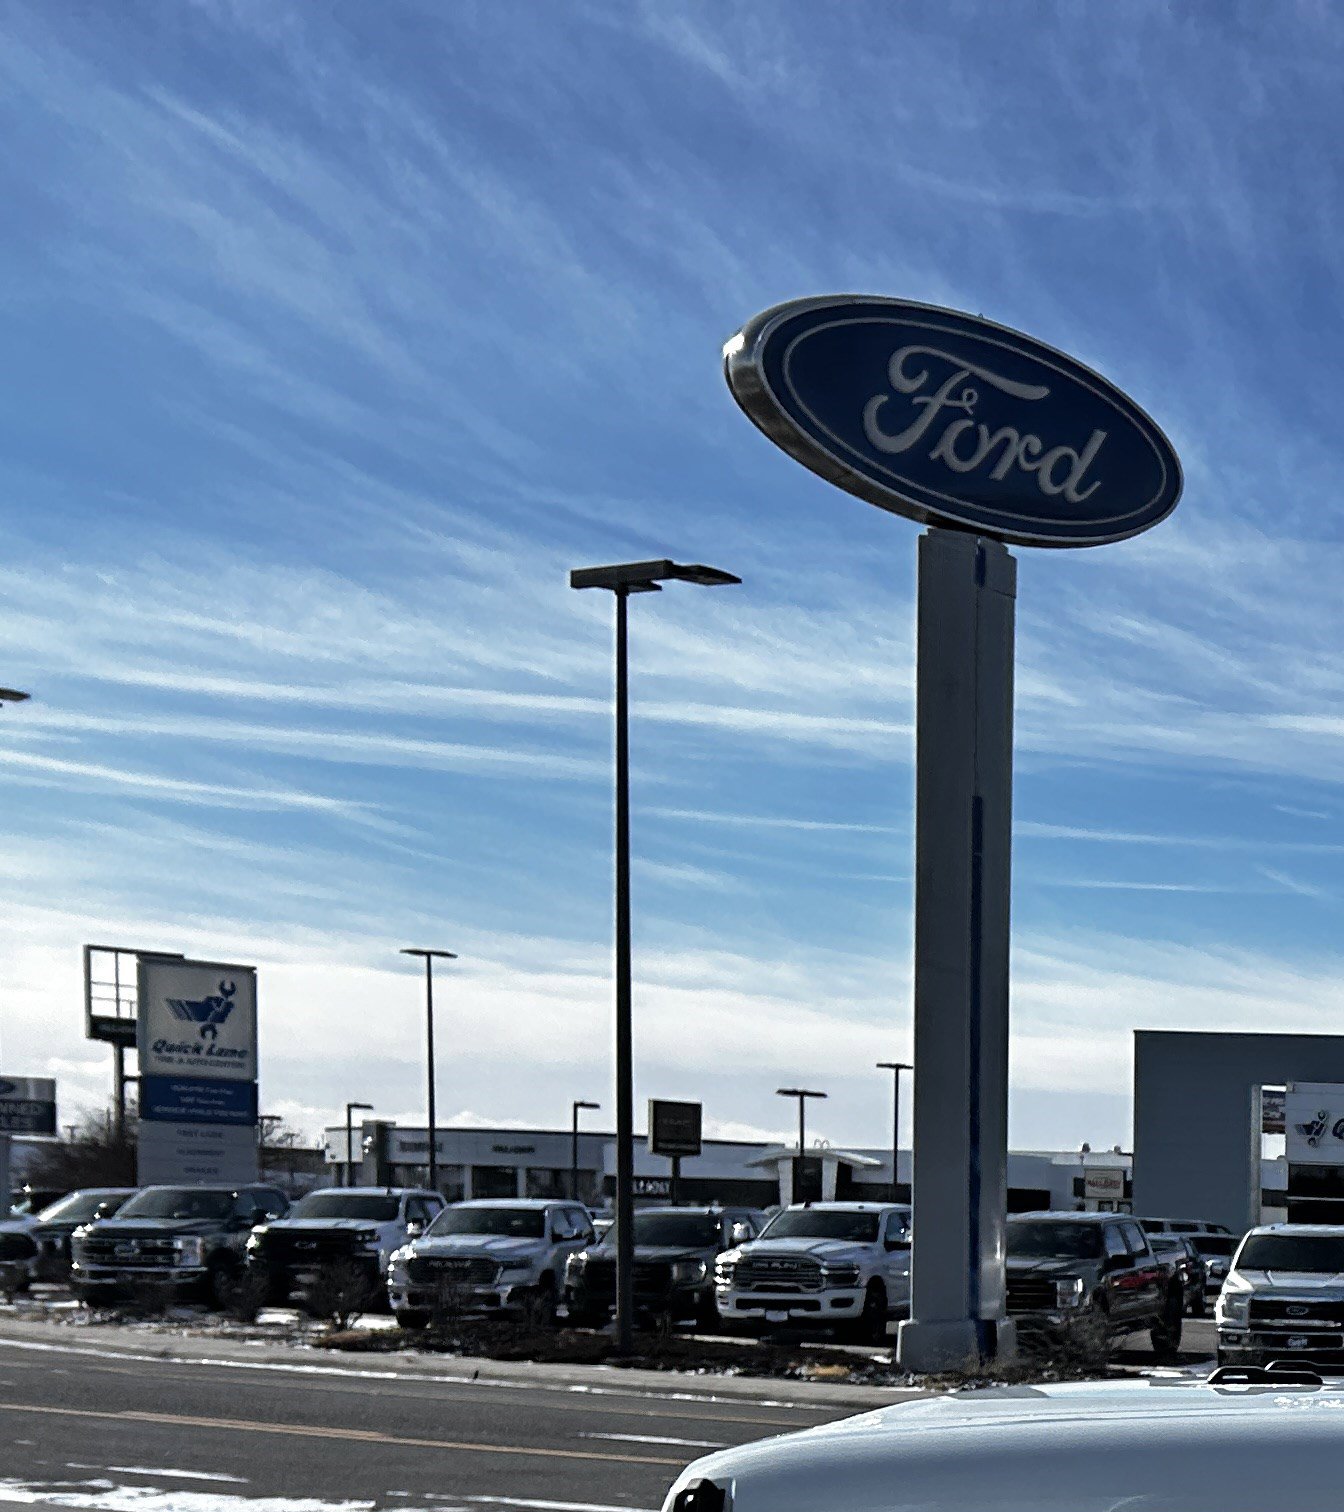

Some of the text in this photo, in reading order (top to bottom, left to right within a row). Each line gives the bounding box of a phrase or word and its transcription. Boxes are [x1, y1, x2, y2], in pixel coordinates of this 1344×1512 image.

[863, 344, 1108, 504] Ford
[152, 1039, 248, 1058] Quick Lane
